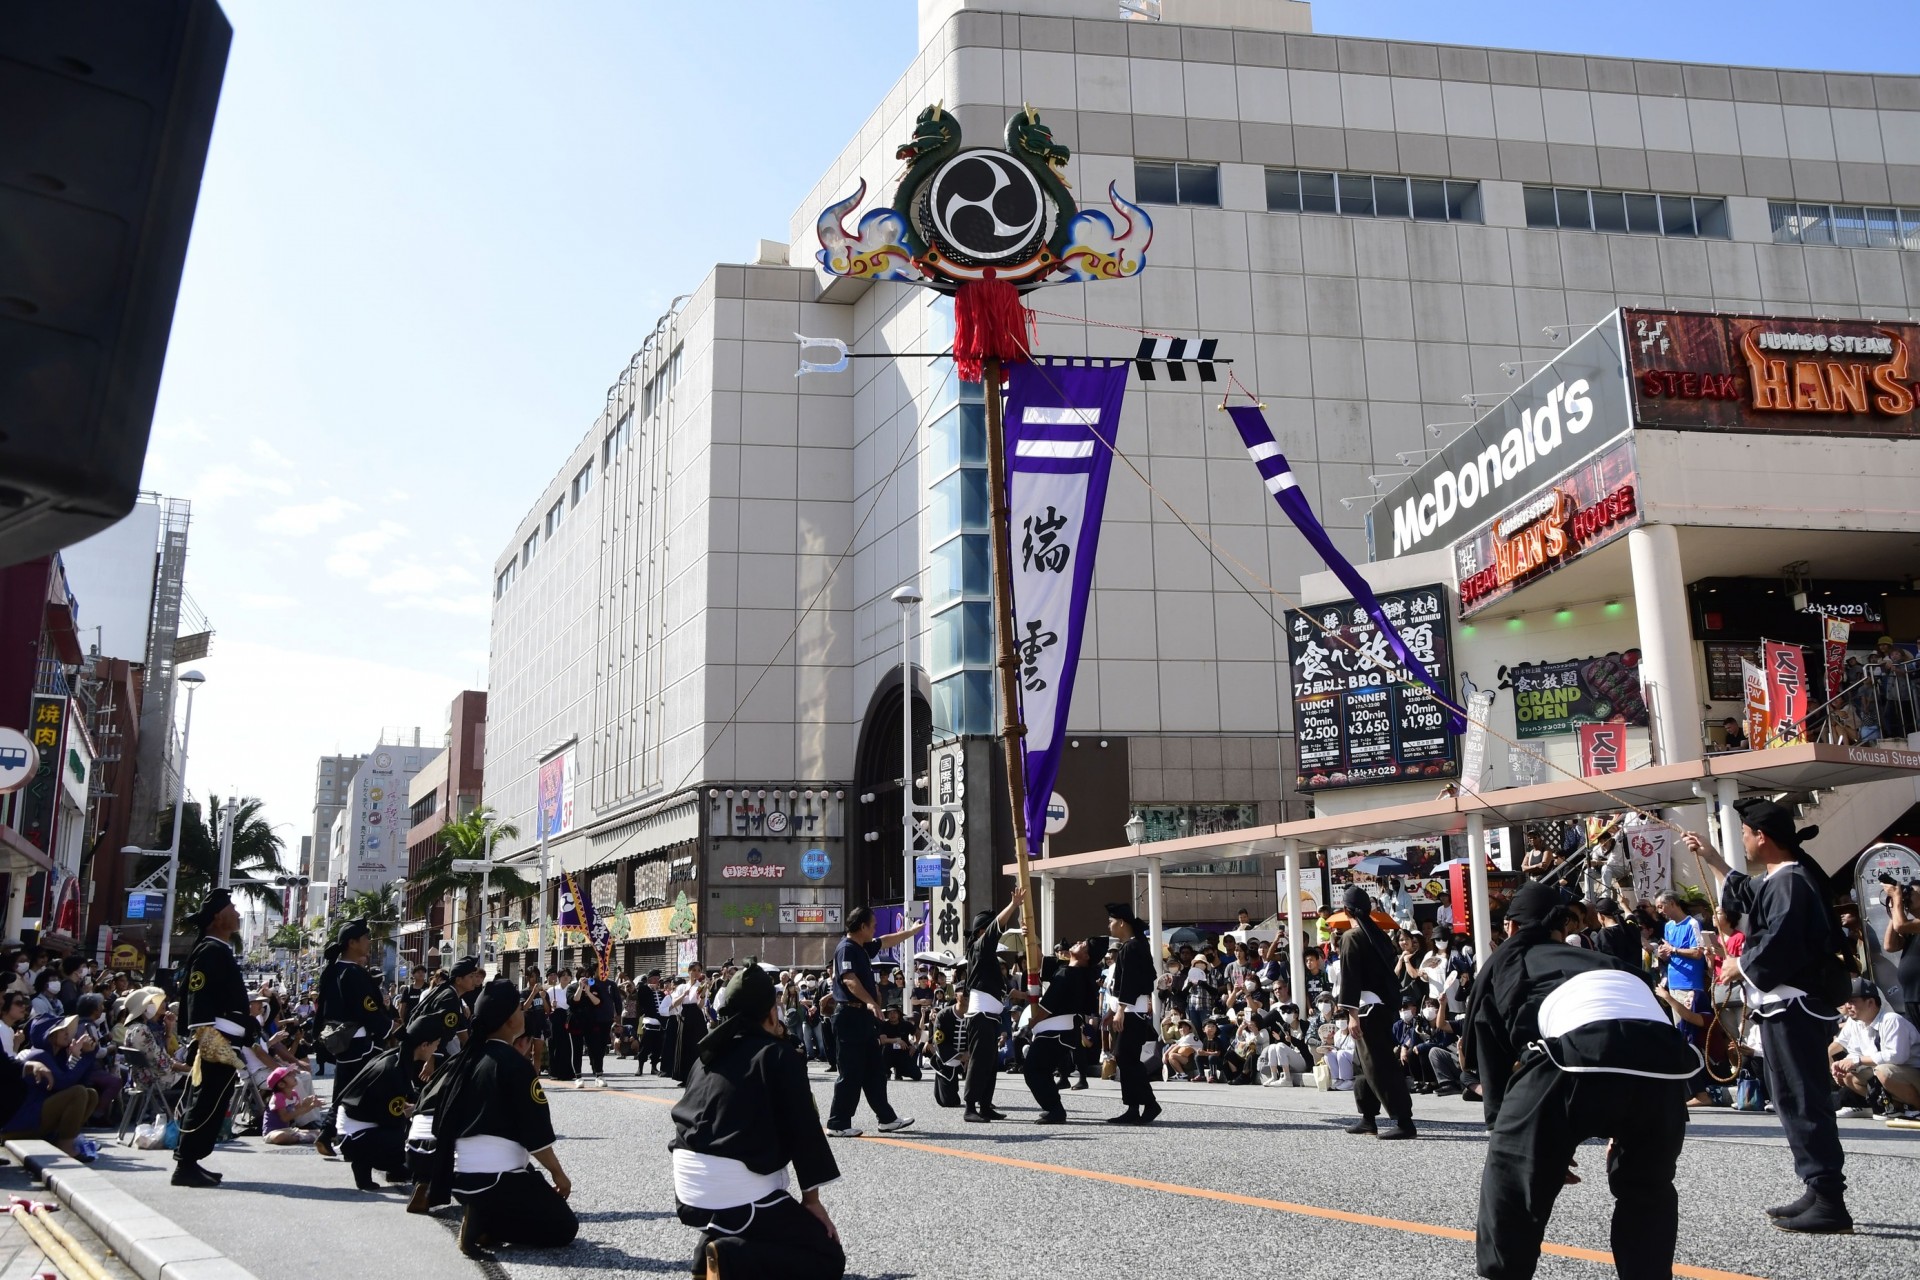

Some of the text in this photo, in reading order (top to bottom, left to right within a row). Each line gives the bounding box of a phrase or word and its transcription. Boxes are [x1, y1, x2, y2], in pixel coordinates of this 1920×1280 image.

[1758, 332, 1893, 354] JUMBO STEAK
[1644, 370, 1740, 400] STEAK
[1750, 357, 1914, 415] HAN'S
[1393, 379, 1593, 557] McDonald's
[1492, 508, 1568, 586] HAN'S
[1573, 485, 1636, 542] HOUSE
[1017, 506, 1071, 692] 瑞雲
[1294, 617, 1309, 635] 牛
[1323, 613, 1339, 628] 豚
[1410, 596, 1438, 615] 焼肉
[1840, 604, 1863, 614] 029
[1350, 624, 1374, 633] CHICKEN
[1411, 613, 1441, 623] YAKINIKU
[1349, 673, 1382, 688] BBQ
[1301, 700, 1334, 712] LUNCH
[1347, 692, 1387, 705] DINNER
[1516, 687, 1582, 706] GRAND
[1351, 710, 1386, 722] 120min
[1405, 704, 1437, 715] 90min
[1518, 703, 1568, 722] OPEN
[34, 704, 60, 746] 焼肉
[1304, 717, 1332, 727] 90min
[1349, 719, 1390, 734] ¥3,650
[1401, 713, 1442, 728] ¥1,980
[1300, 725, 1338, 741] ¥2,500
[1848, 748, 1888, 763] Kokusai
[1378, 766, 1396, 775] 029
[940, 758, 952, 804] 国際通り
[563, 800, 572, 828] 3F
